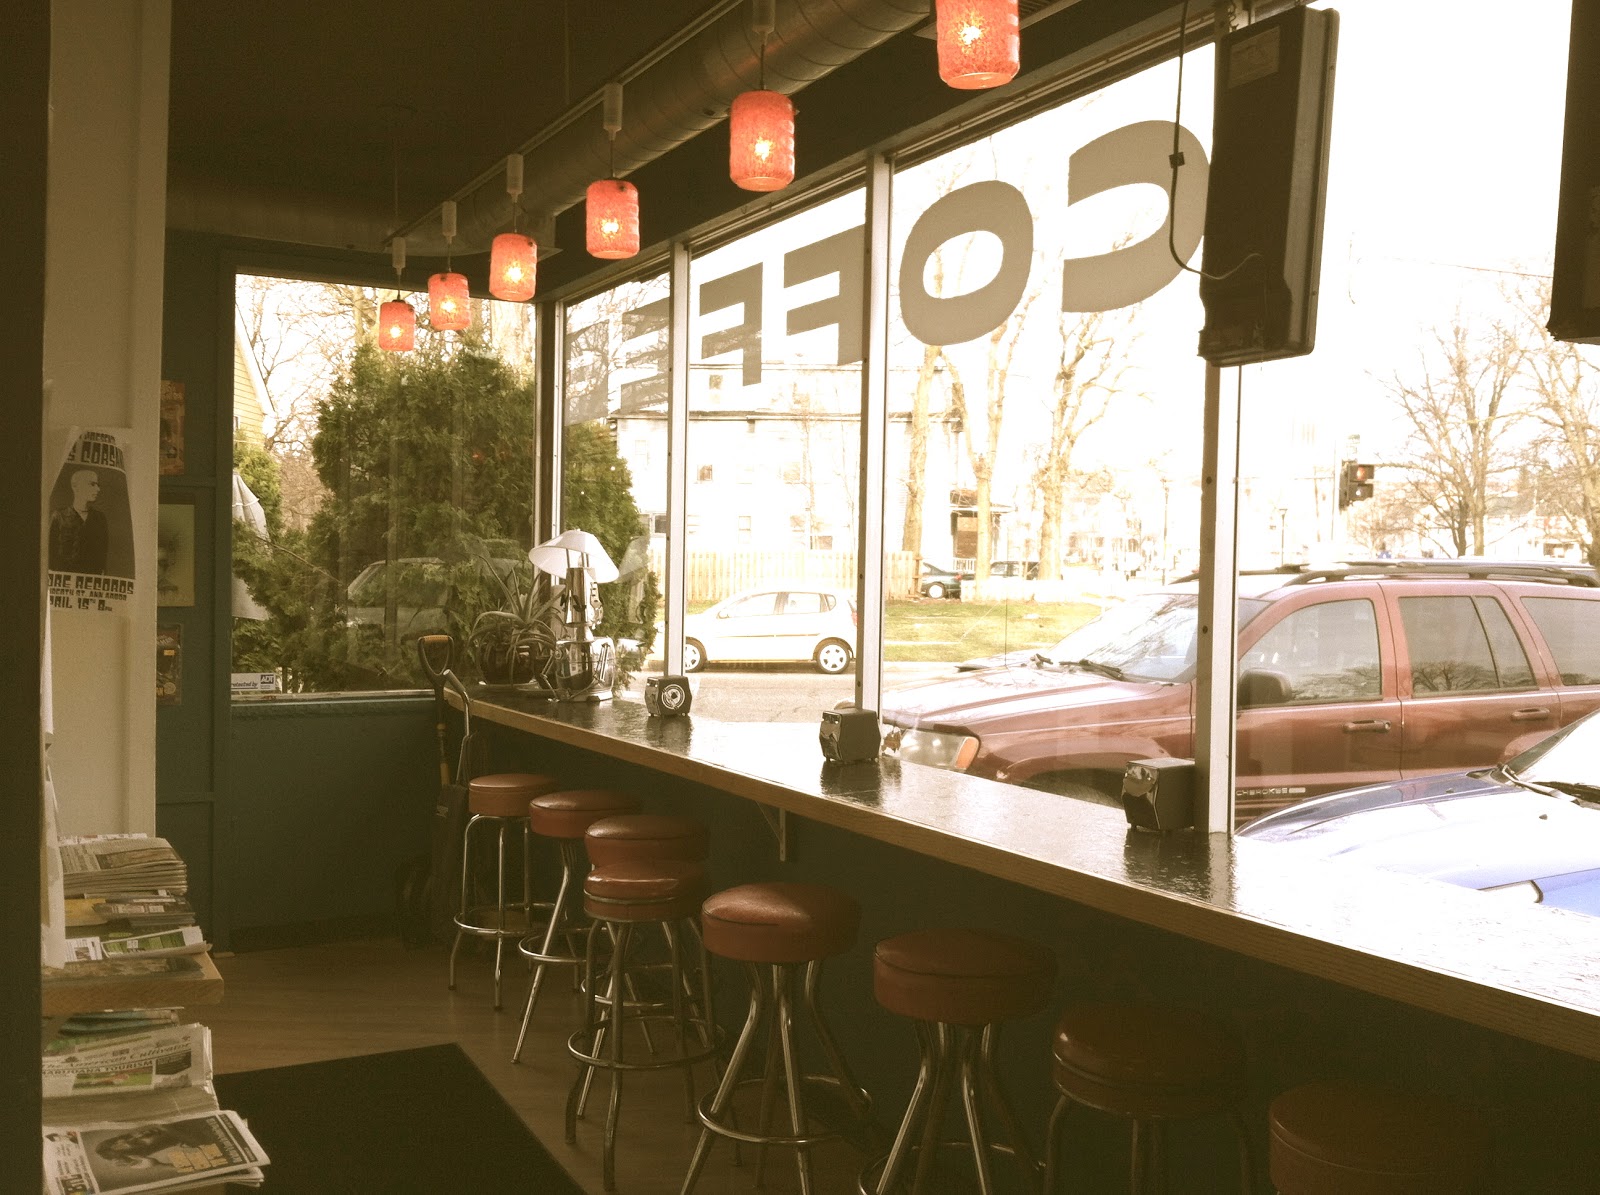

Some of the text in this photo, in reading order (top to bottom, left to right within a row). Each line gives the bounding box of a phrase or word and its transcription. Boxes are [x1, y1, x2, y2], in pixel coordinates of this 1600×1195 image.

[75, 575, 134, 595] RECORDS
[50, 595, 73, 609] PRIL
[260, 674, 274, 684] ADT
[1236, 787, 1288, 796] CHEROKEE
[103, 1060, 154, 1073] TOURISM
